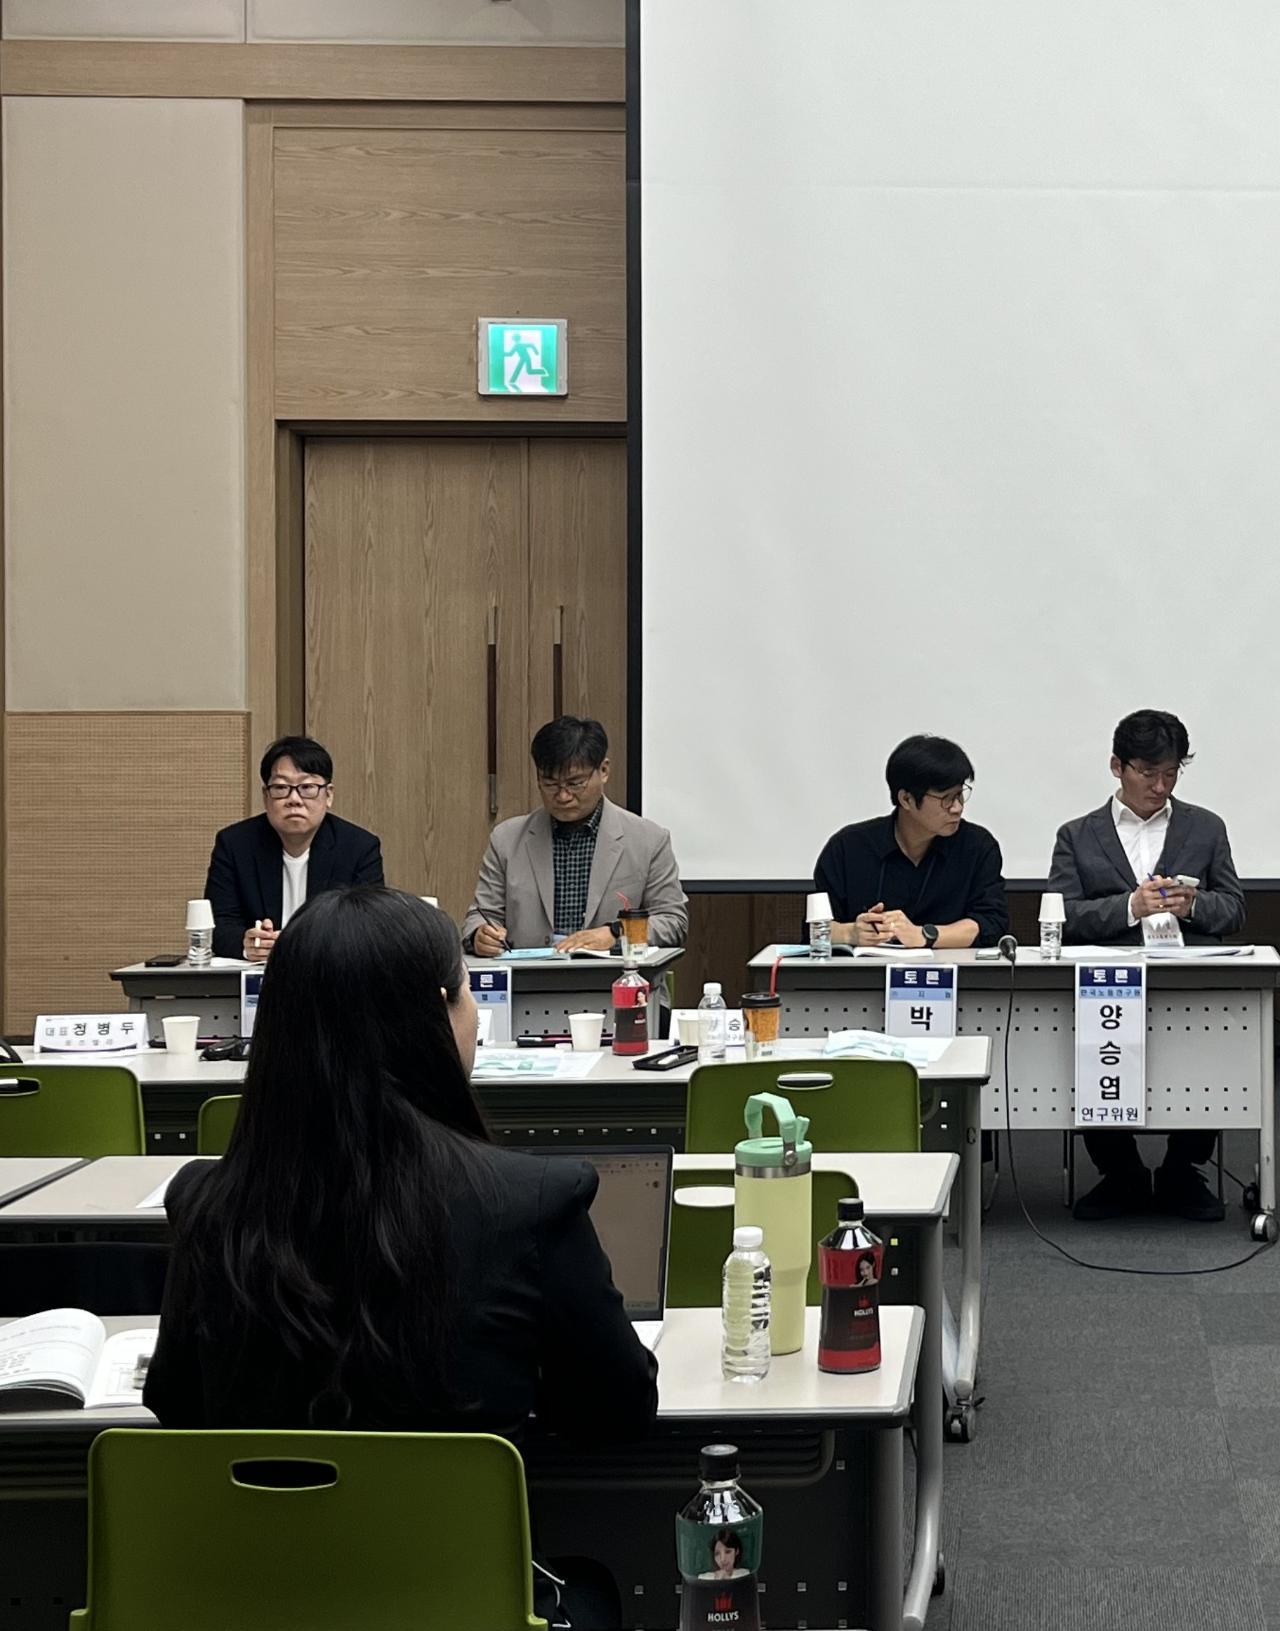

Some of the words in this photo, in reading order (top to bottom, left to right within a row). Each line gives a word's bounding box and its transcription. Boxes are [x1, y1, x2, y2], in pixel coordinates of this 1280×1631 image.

[904, 970, 940, 985] 토론
[1093, 969, 1129, 983] 토론
[1081, 1106, 1139, 1122] 연구위원
[707, 1610, 740, 1622] HOLLYS
